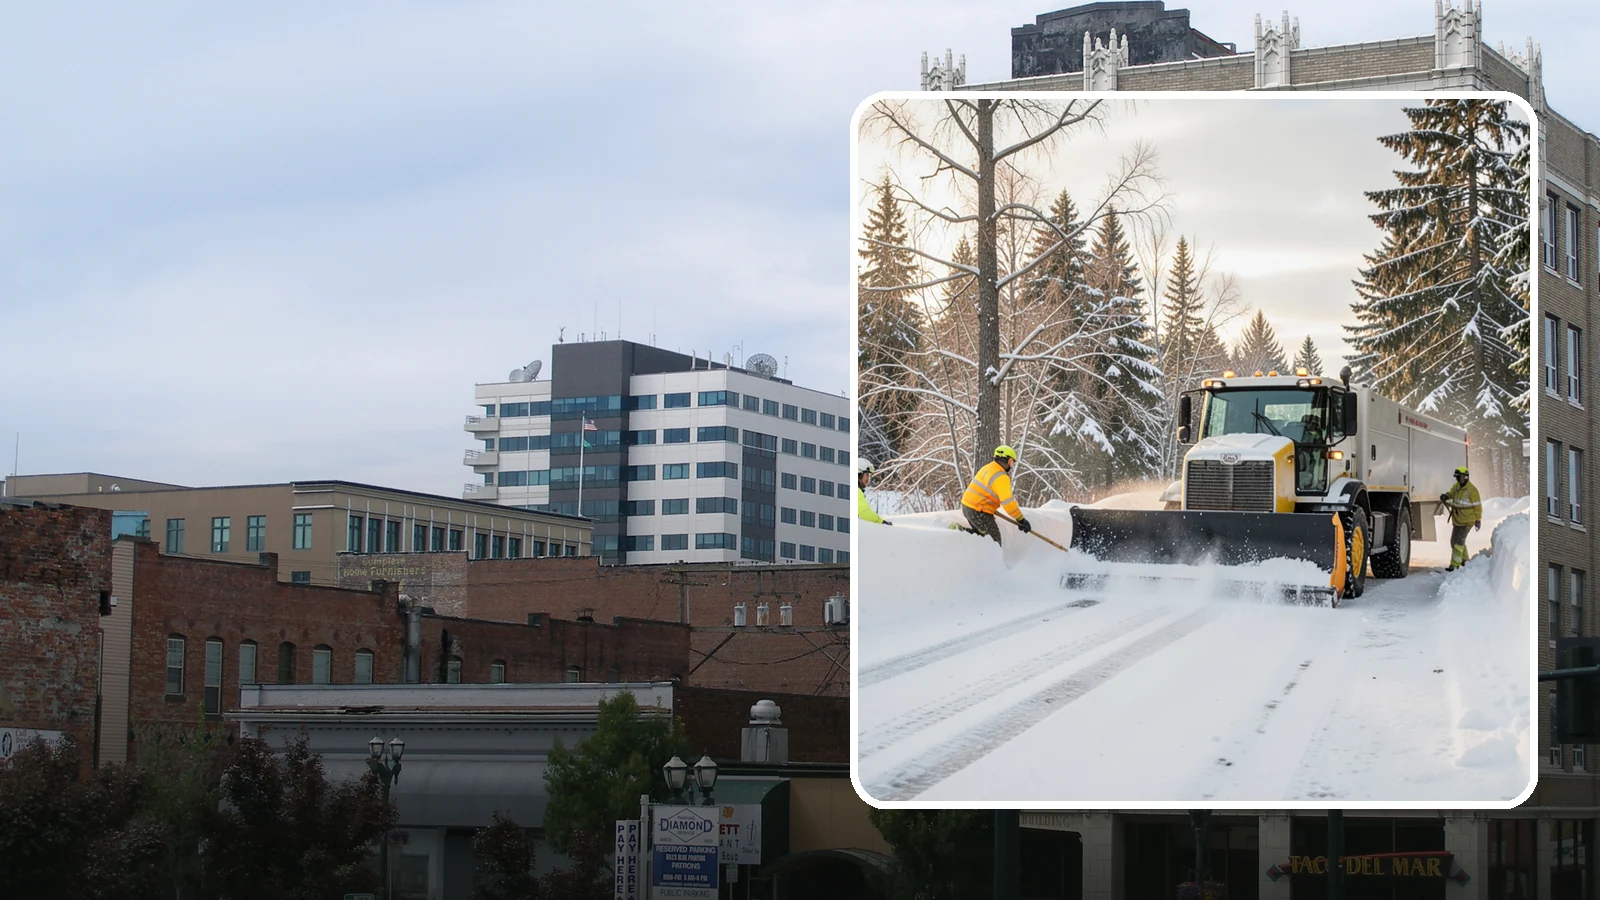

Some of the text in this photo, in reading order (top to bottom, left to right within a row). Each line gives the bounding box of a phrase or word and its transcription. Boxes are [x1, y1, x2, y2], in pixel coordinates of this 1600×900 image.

[343, 566, 427, 577] Home Furnishers
[660, 818, 713, 833] DIAMOND
[1022, 815, 1070, 828] BUILDING
[656, 845, 716, 854] RESERVED PARKING
[616, 825, 625, 893] PAY HERE
[627, 824, 637, 893] PAY HERE
[721, 851, 739, 862] Soup
[671, 862, 701, 870] PATRONS
[1345, 856, 1386, 876] DEL
[1392, 857, 1443, 877] MAR
[660, 889, 710, 898] PUBLIC PARKING
